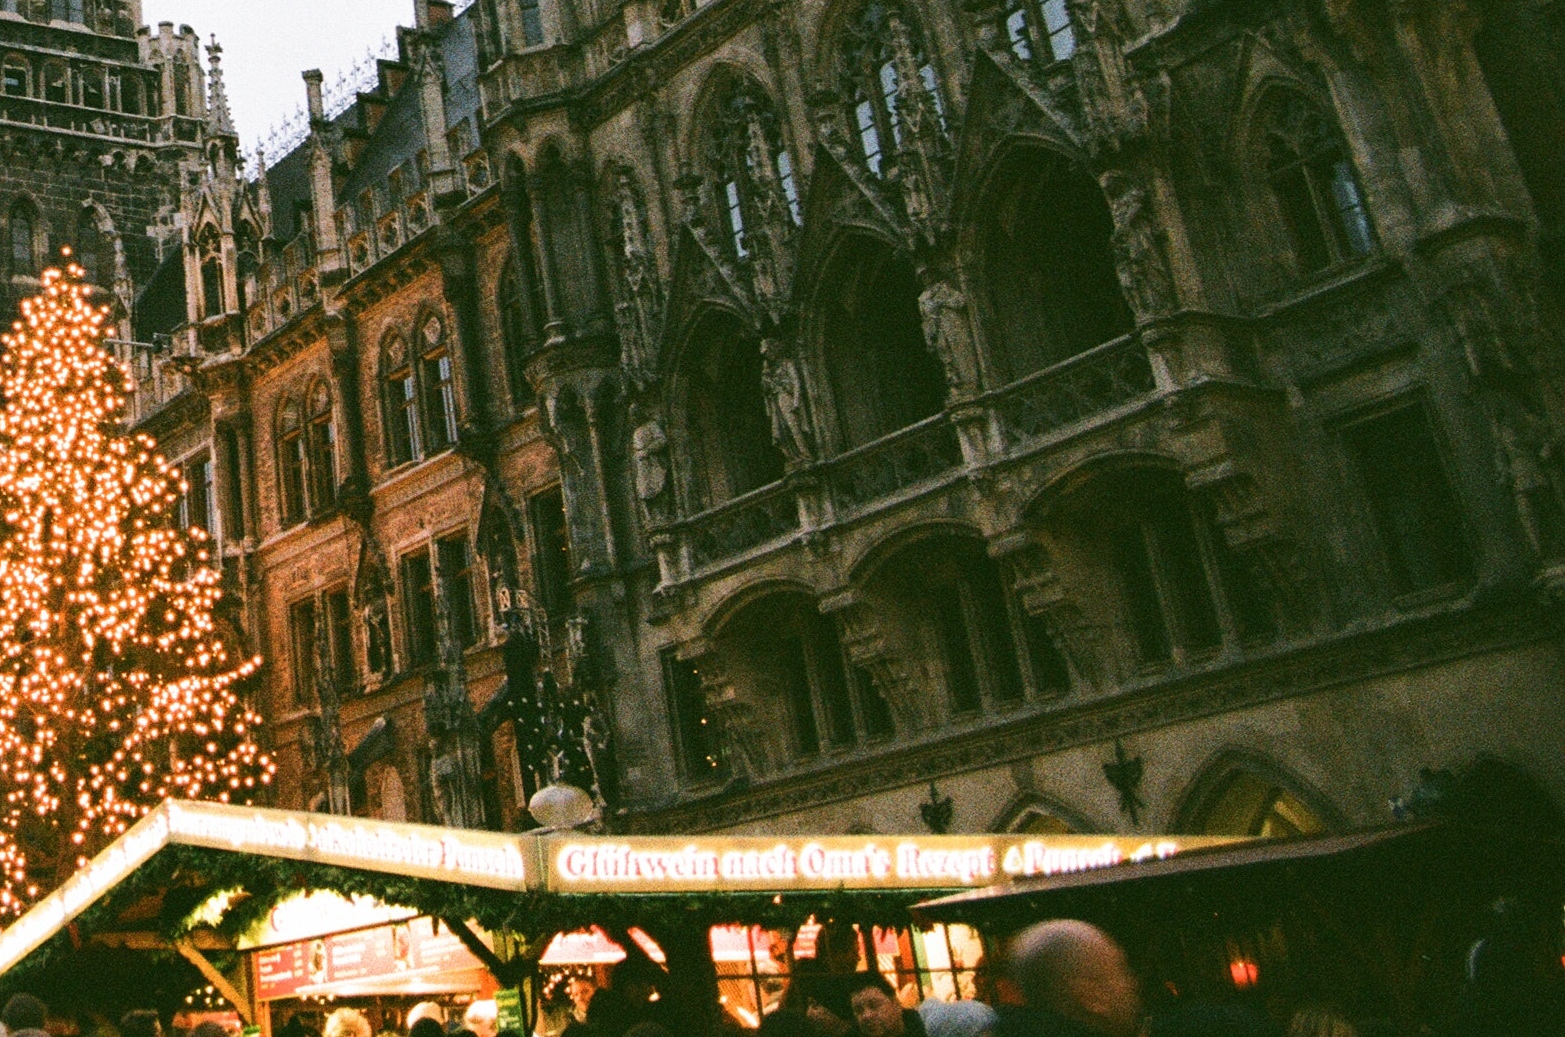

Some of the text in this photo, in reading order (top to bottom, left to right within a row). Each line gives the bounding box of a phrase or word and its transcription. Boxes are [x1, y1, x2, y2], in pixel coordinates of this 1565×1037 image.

[441, 838, 521, 878] Punsch
[563, 843, 720, 878] Glühwein
[726, 845, 798, 878] nach
[805, 844, 892, 878] Oma's
[900, 845, 996, 881] Rezept
